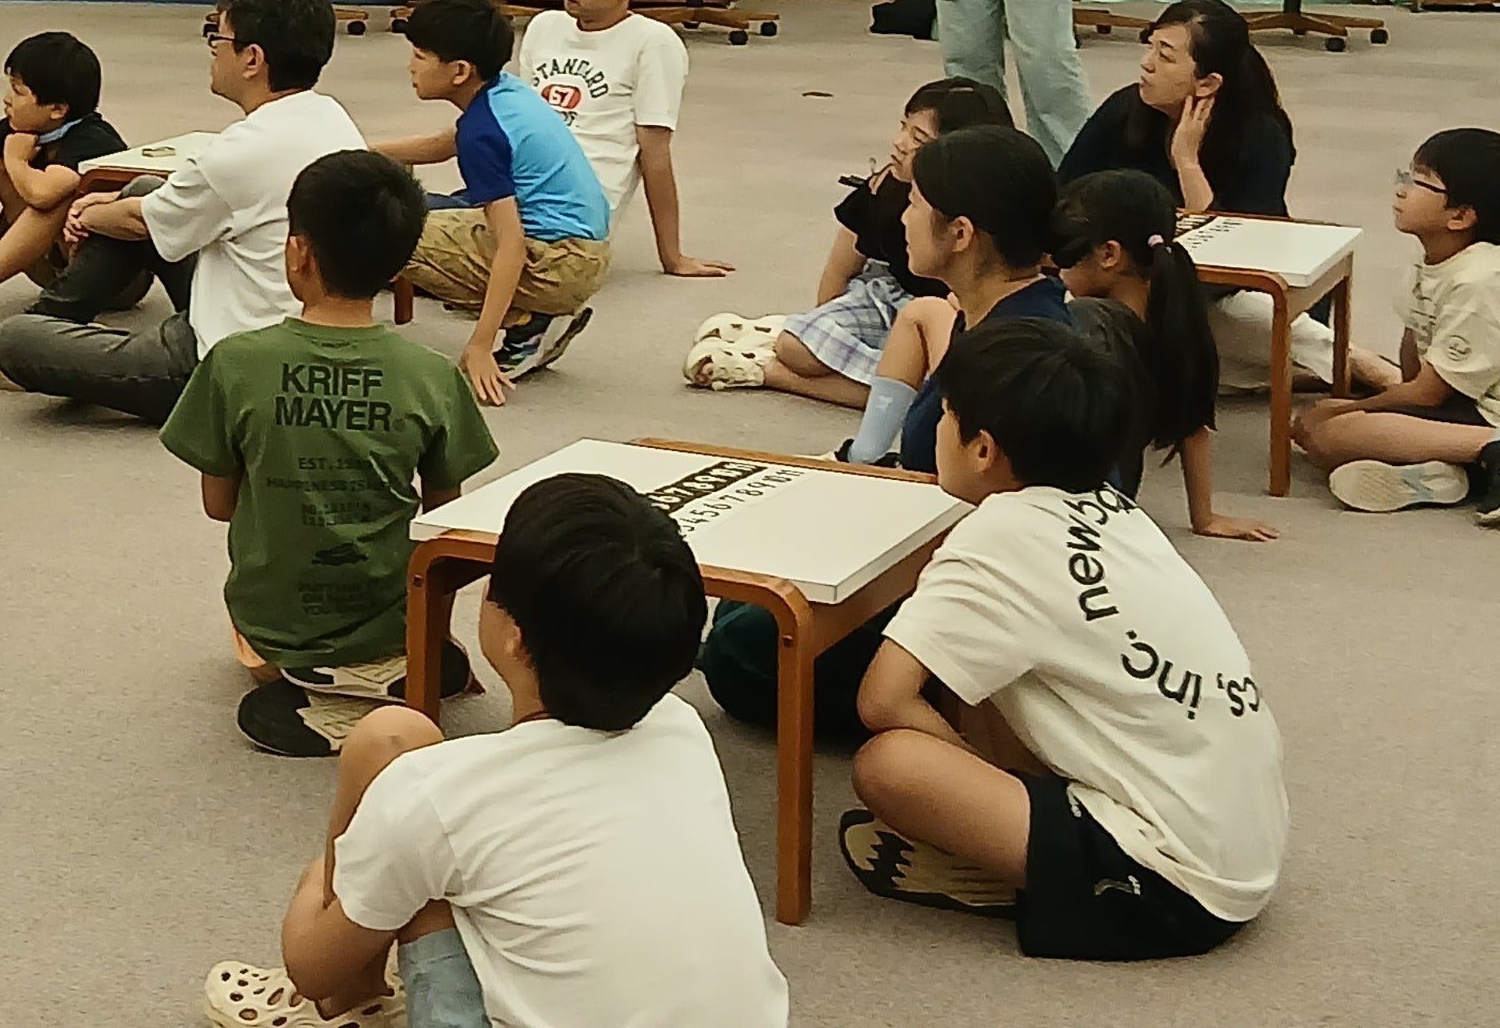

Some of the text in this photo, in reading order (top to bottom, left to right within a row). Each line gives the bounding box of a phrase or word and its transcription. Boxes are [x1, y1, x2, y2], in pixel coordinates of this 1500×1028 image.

[281, 363, 384, 398] KRIFF
[275, 395, 392, 432] MAYER
[1120, 630, 1202, 720] inc.
